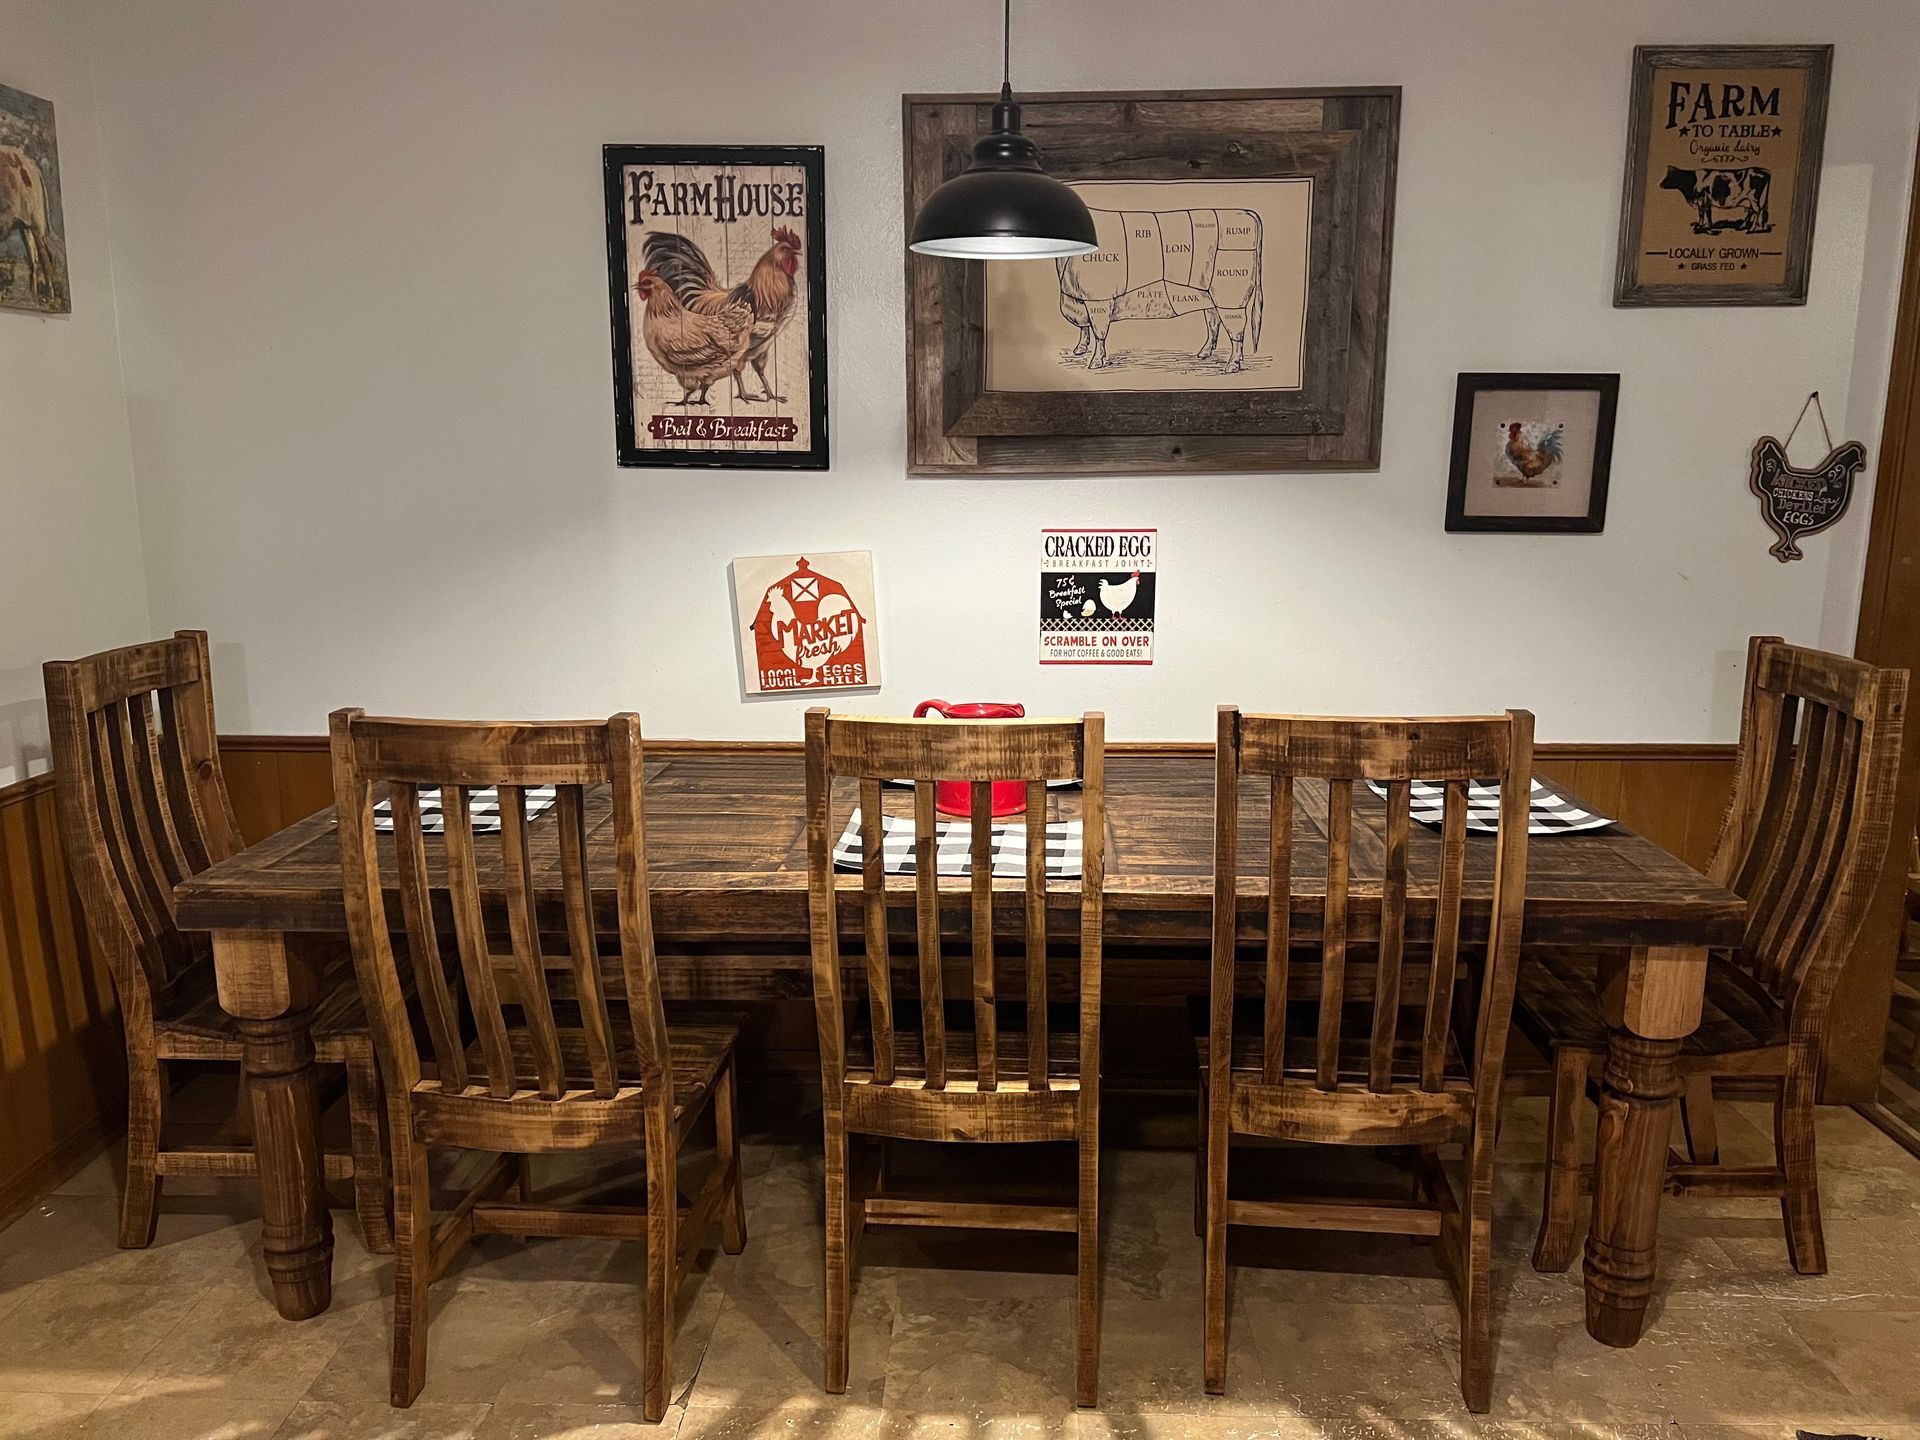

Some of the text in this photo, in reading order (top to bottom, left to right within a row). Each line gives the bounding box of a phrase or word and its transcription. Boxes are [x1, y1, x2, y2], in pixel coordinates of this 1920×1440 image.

[1665, 81, 1781, 130] FARM
[1692, 124, 1770, 138] TO TABLE
[1690, 139, 1760, 156] Organic dairy
[628, 170, 804, 225] FARMHOUSE
[1135, 229, 1151, 238] RIB
[1226, 226, 1251, 235] RUMP
[1165, 243, 1191, 253] LOIN
[1669, 247, 1759, 259] LOCALLY GROWN
[1082, 253, 1120, 263] CHUCK
[1216, 268, 1248, 277] ROUND
[1691, 262, 1735, 271] GRASS FED
[1137, 290, 1163, 299] PLATE
[1172, 294, 1200, 303] FLANK
[660, 417, 790, 441] Bed & Breakfast
[1773, 487, 1815, 502] CHICKENS
[1777, 499, 1827, 515] Deviled
[1783, 511, 1815, 526] EGGS
[1045, 535, 1151, 557] CRACKED EGG
[1052, 559, 1145, 568] BREAKFAST JOINT
[1049, 585, 1086, 600] Breakfast
[1055, 595, 1082, 610] Special
[777, 609, 853, 647] MARKET
[1044, 636, 1150, 647] SCRAMBLE ON OVER
[796, 635, 842, 667] fresh
[1050, 649, 1142, 657] FOR HOT COFFEE & GOOD EATS!
[822, 663, 863, 677] EGGS
[761, 668, 800, 688] LOCAL
[823, 674, 864, 685] MILK
